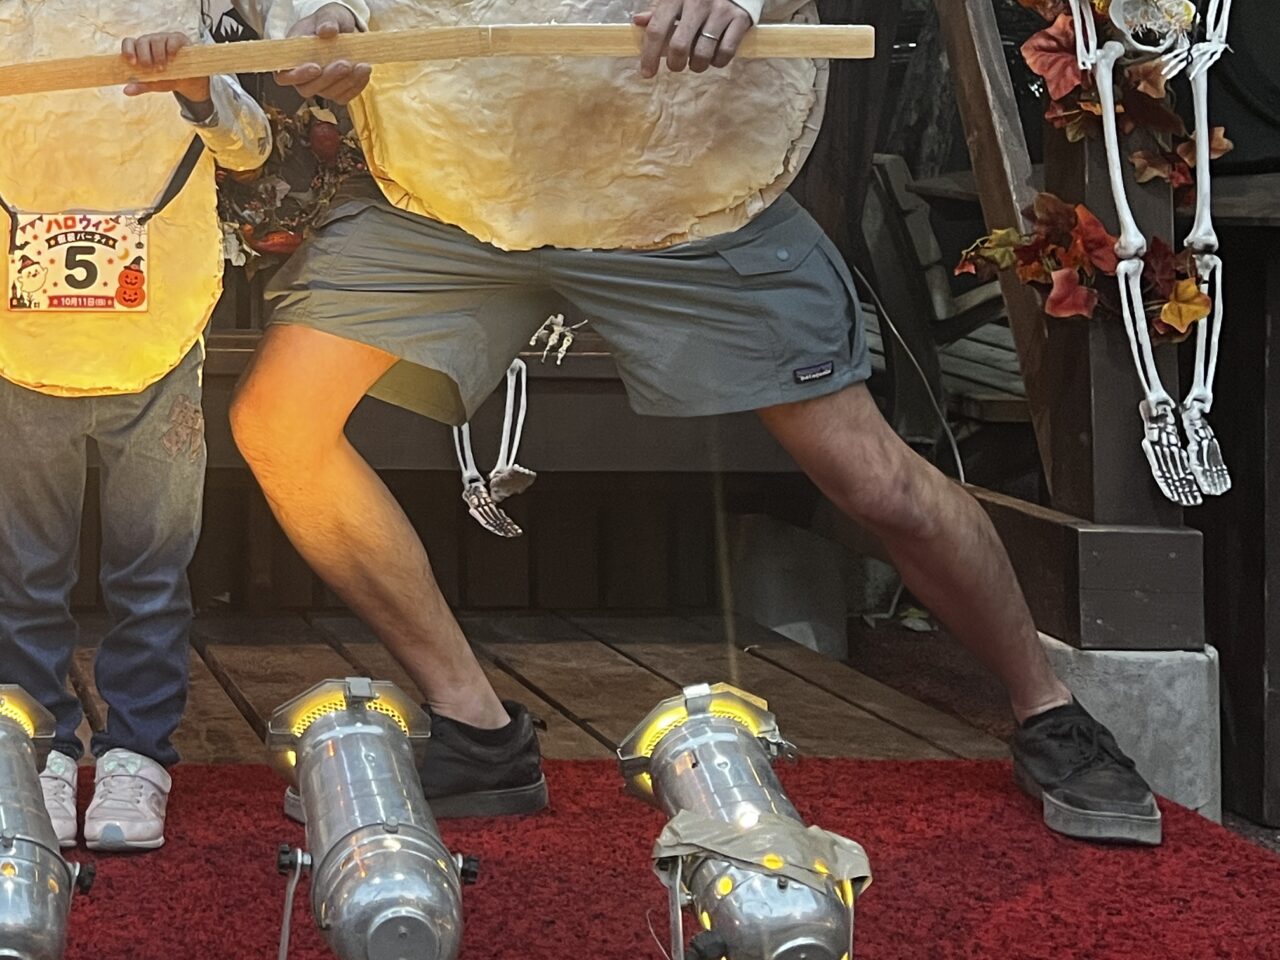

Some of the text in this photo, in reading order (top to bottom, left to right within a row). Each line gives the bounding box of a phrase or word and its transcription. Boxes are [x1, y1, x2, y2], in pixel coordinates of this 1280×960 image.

[46, 215, 117, 233] ハロウィン
[64, 245, 98, 290] 5
